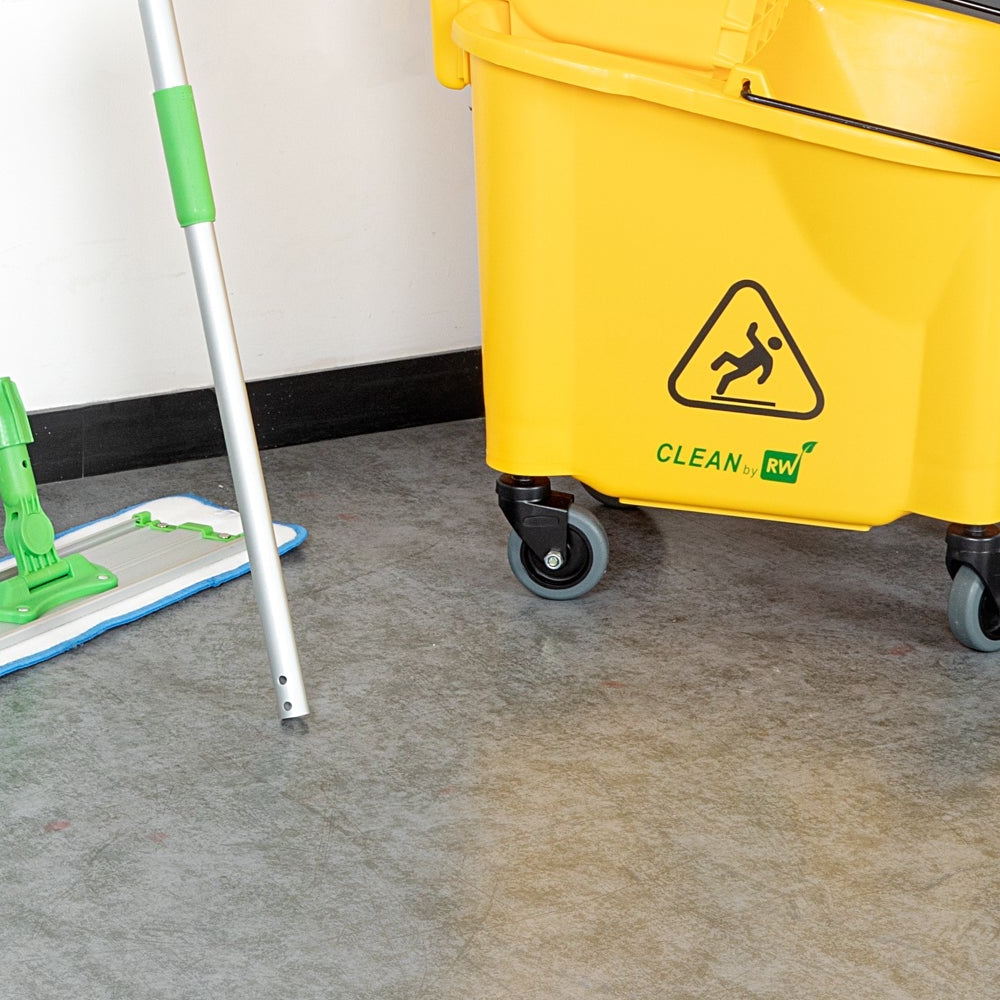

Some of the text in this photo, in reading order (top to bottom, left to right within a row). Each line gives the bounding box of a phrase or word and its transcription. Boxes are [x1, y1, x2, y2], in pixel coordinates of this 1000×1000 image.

[656, 442, 799, 478] CLEAN by RW
